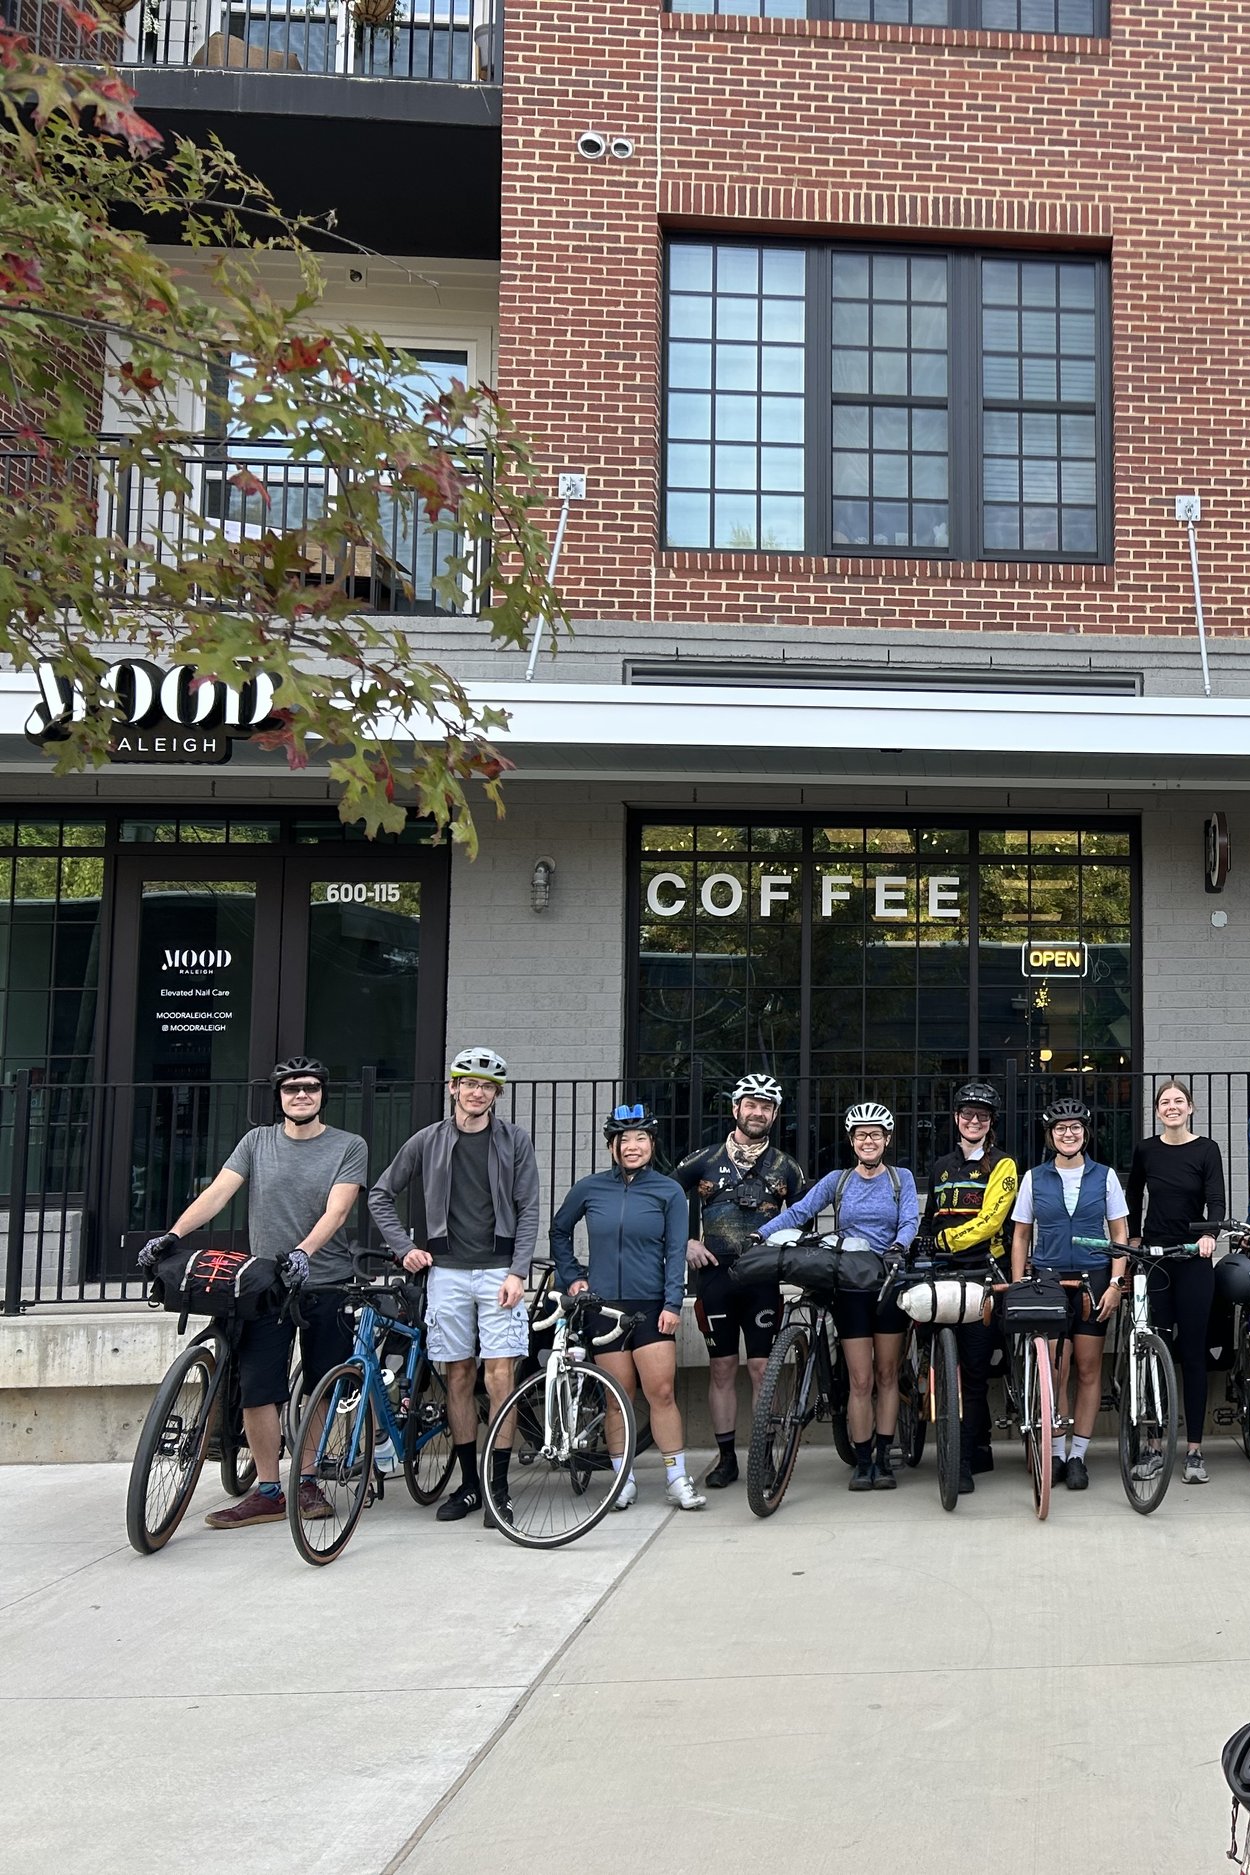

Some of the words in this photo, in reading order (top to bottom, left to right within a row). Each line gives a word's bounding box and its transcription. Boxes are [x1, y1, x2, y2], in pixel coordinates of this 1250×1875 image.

[108, 737, 216, 752] ALEIGH
[326, 883, 400, 902] 600-115
[647, 872, 961, 918] COFFEE
[161, 949, 232, 971] MOOD
[1029, 949, 1081, 968] OPEN
[160, 989, 194, 997] Elevated
[195, 989, 211, 997] Nail
[212, 989, 230, 997] Care
